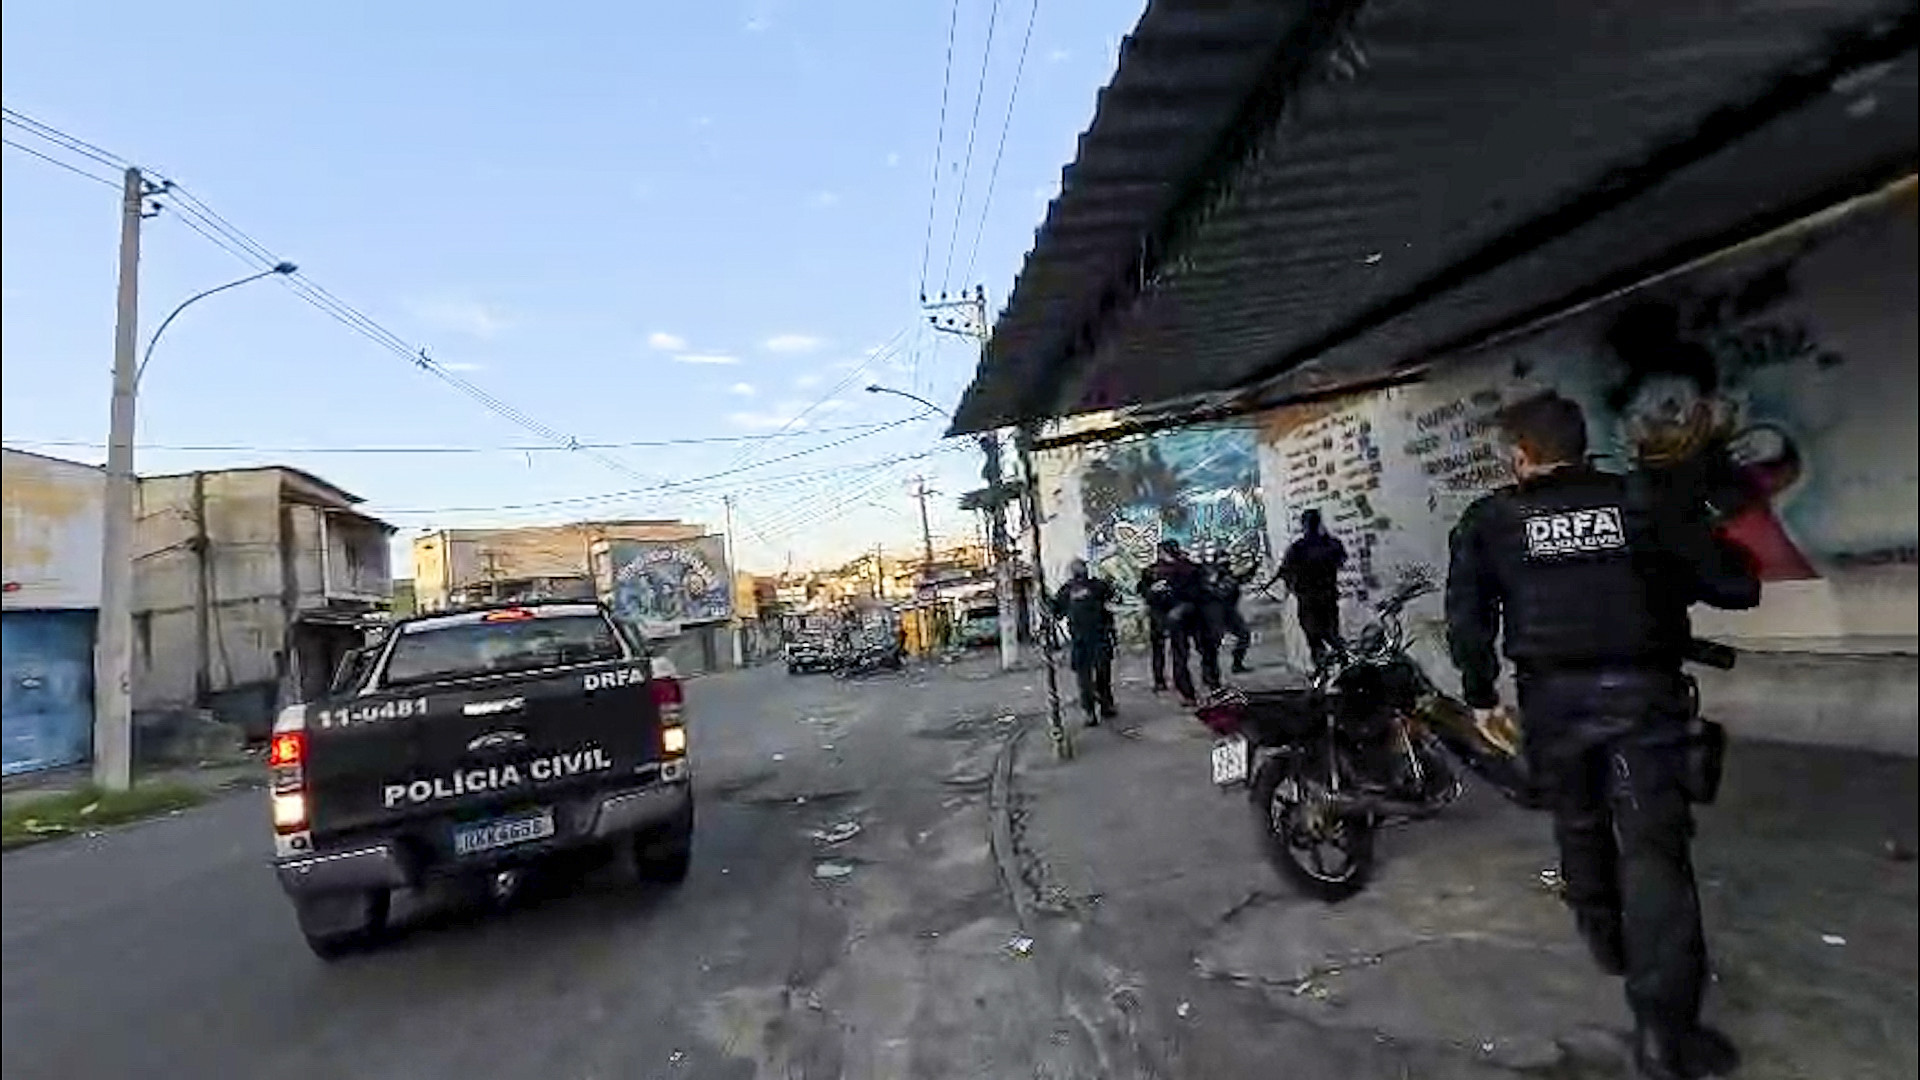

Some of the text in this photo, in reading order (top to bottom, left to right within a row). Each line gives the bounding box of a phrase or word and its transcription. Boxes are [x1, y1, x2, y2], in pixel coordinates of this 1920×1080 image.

[1531, 511, 1618, 541] DRFA
[583, 668, 645, 690] DRFA
[384, 748, 612, 808] POLÍCIA CIVIL
